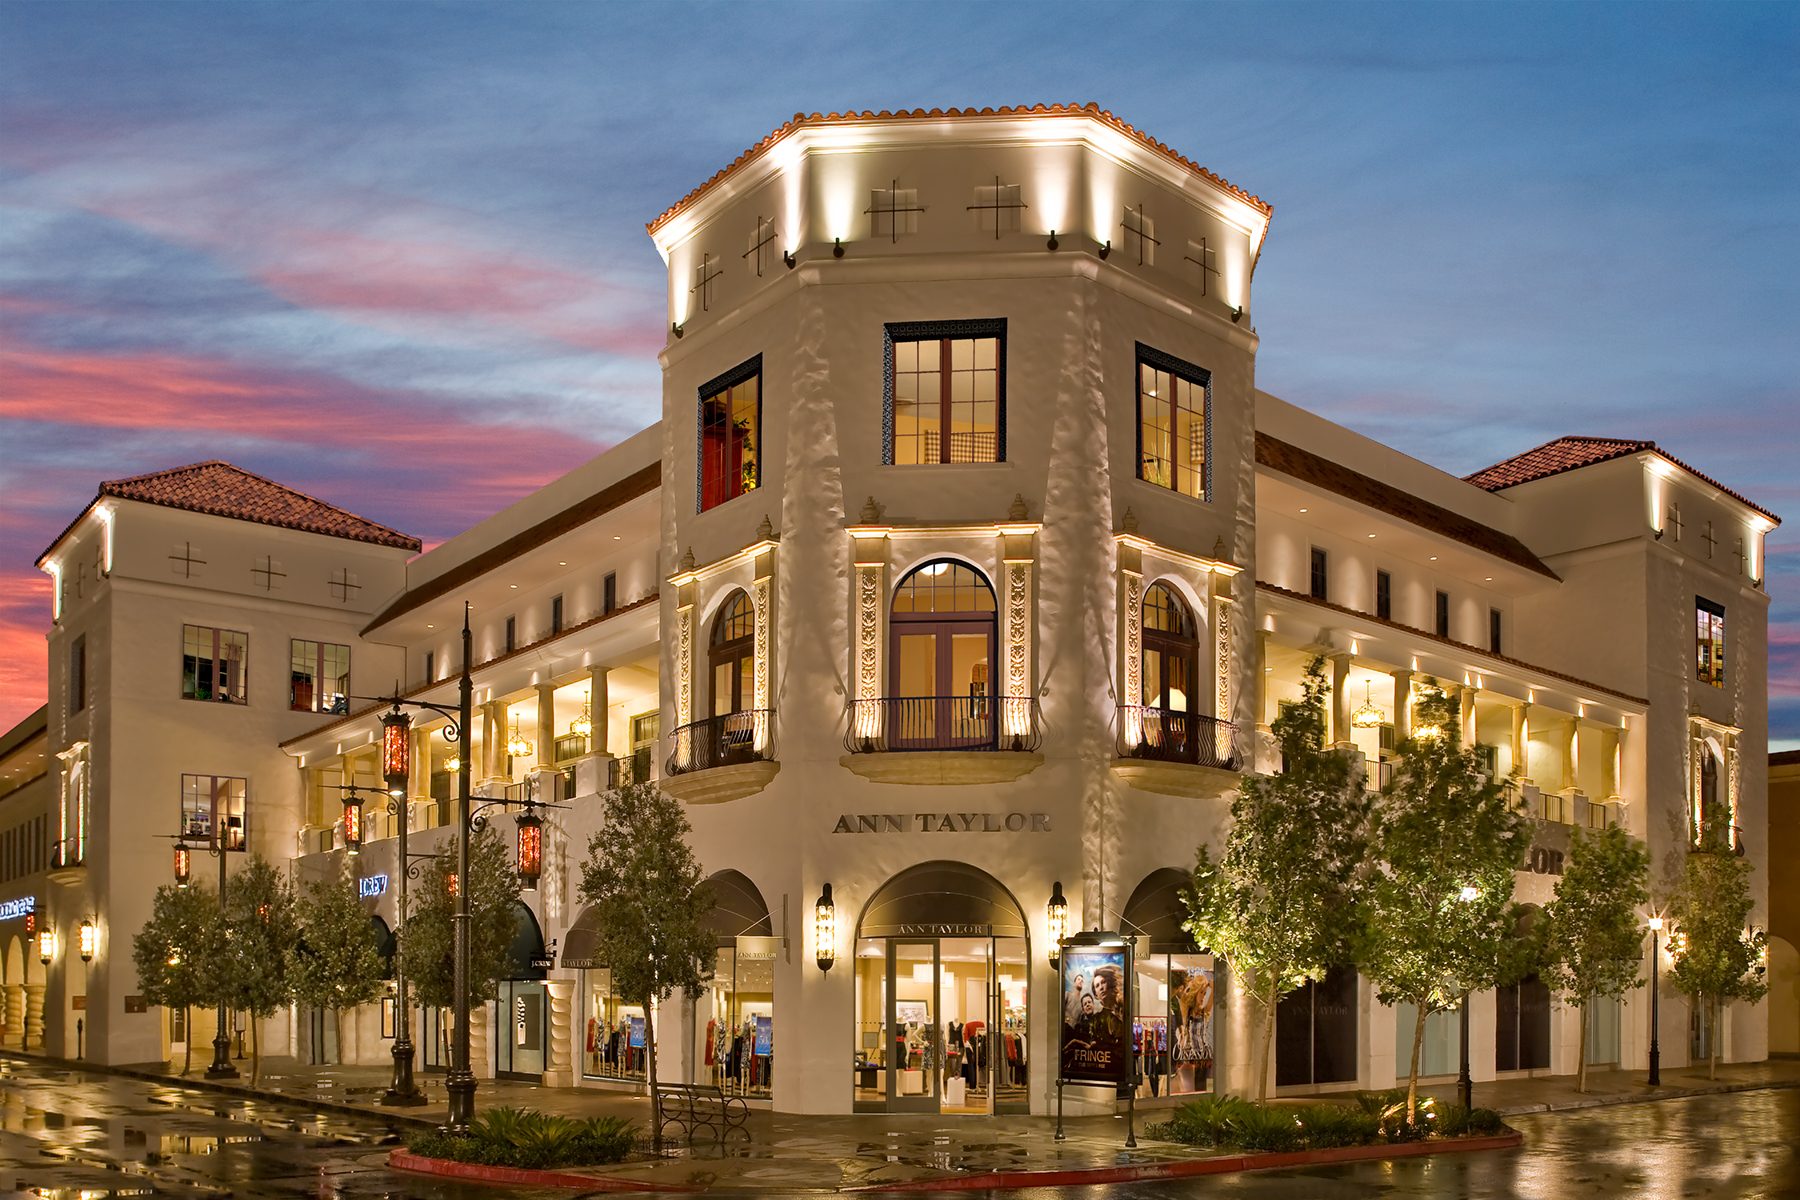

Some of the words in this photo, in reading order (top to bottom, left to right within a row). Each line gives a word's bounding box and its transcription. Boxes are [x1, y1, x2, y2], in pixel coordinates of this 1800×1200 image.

[832, 814, 902, 833] ANN
[915, 812, 1052, 833] TAYLOR
[898, 924, 926, 934] ANN
[929, 924, 983, 934] TAYLOR
[1074, 1049, 1112, 1063] FRINGE
